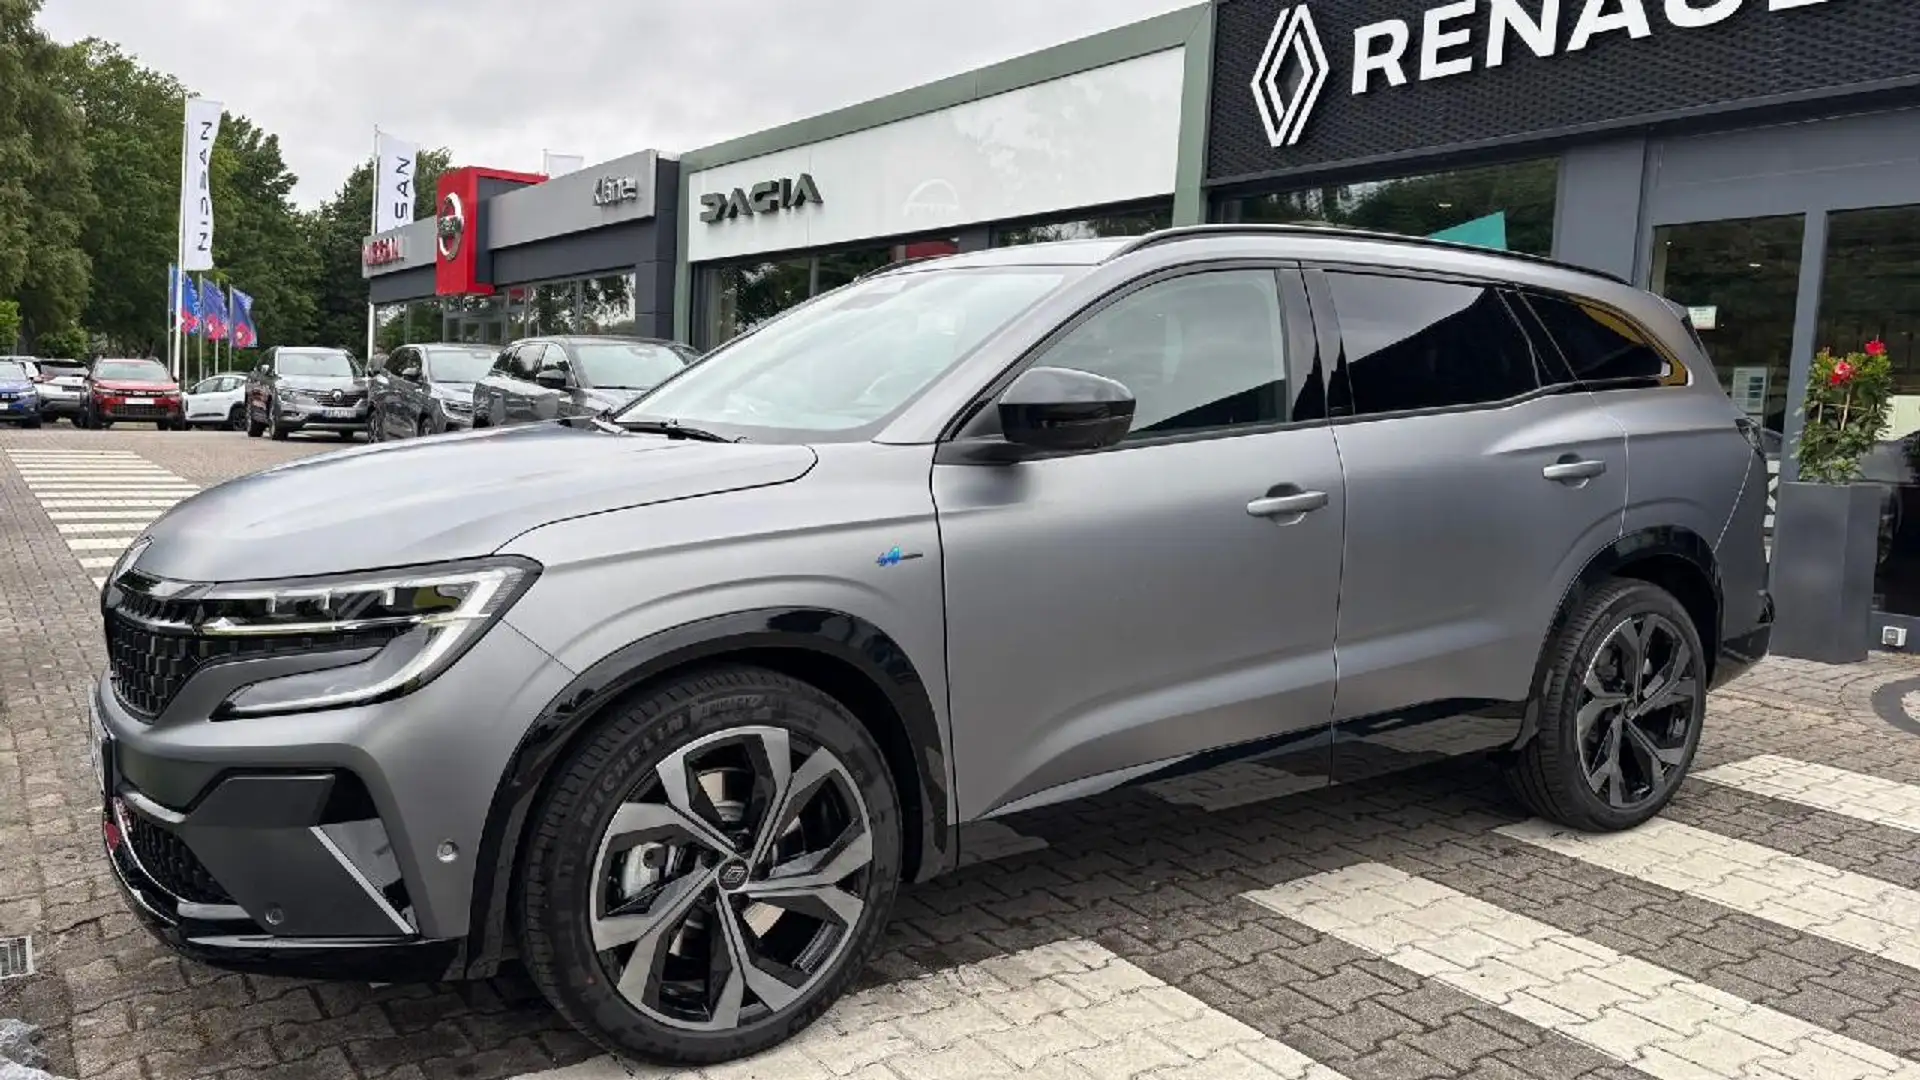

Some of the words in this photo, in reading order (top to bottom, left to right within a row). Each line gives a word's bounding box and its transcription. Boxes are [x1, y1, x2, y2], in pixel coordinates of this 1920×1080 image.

[1352, 0, 1828, 95] RENA
[197, 121, 213, 251] NISSAN
[700, 173, 824, 224] DACIA
